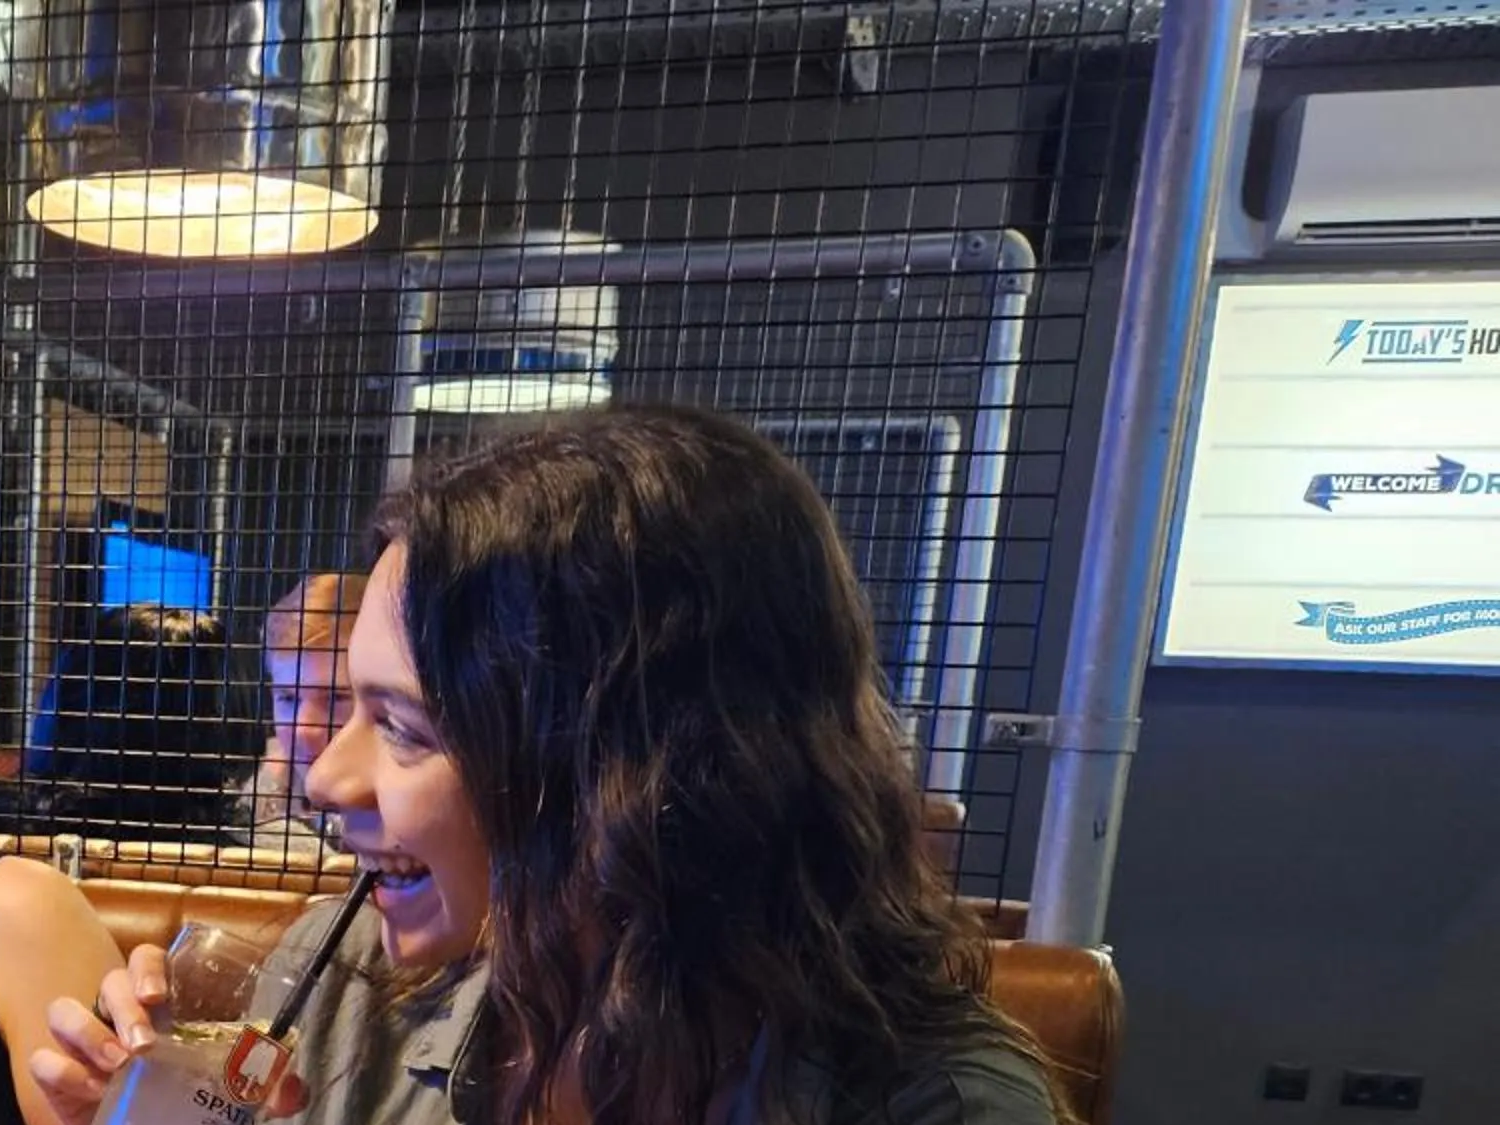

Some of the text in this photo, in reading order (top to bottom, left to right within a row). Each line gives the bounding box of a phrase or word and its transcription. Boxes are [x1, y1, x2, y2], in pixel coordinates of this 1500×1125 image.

[1367, 328, 1466, 355] TODAY'S
[1331, 475, 1443, 491] WELCOME
[1334, 623, 1363, 635] ASK
[1367, 621, 1397, 635] OUR
[1400, 615, 1440, 631] STAFF
[1443, 611, 1472, 625] FOR
